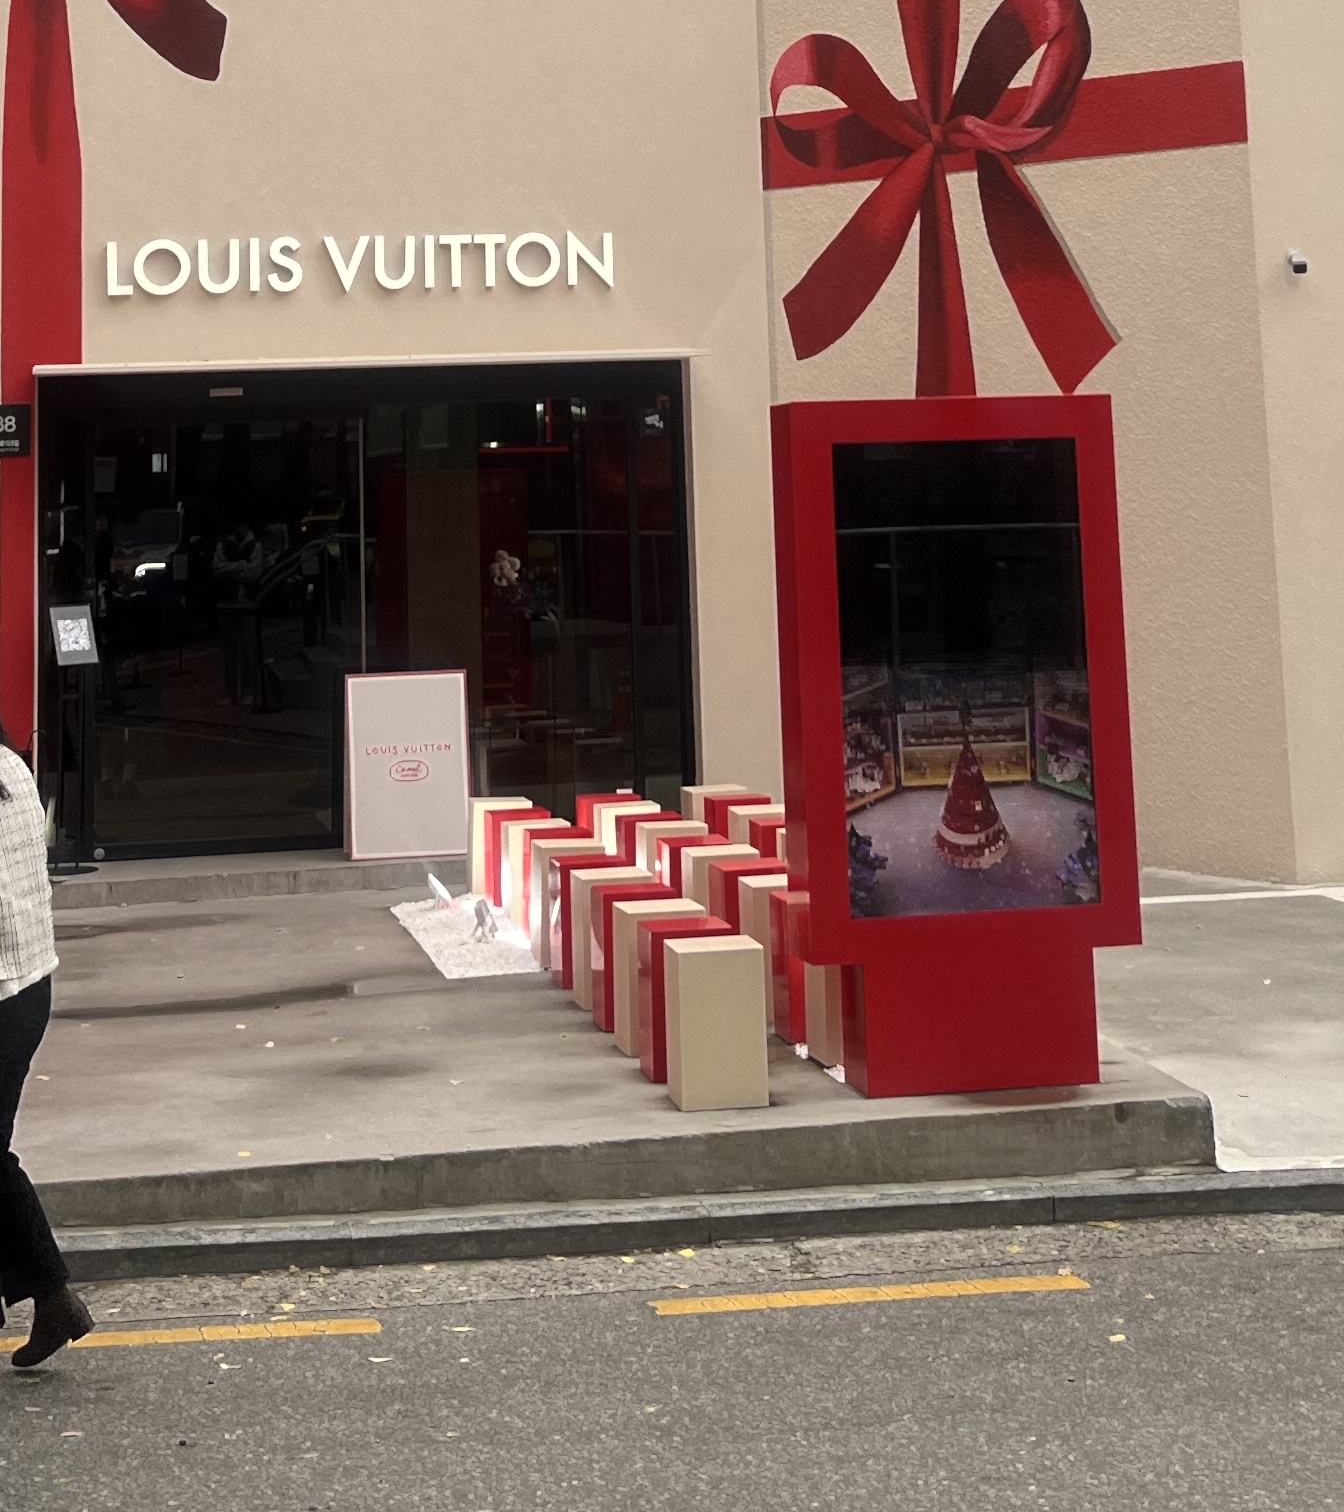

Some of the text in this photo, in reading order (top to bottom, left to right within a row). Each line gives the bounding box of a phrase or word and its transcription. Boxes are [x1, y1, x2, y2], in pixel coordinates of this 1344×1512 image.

[106, 231, 614, 296] LOUIS VUITTON
[365, 743, 451, 756] LOUIS VUITTON
